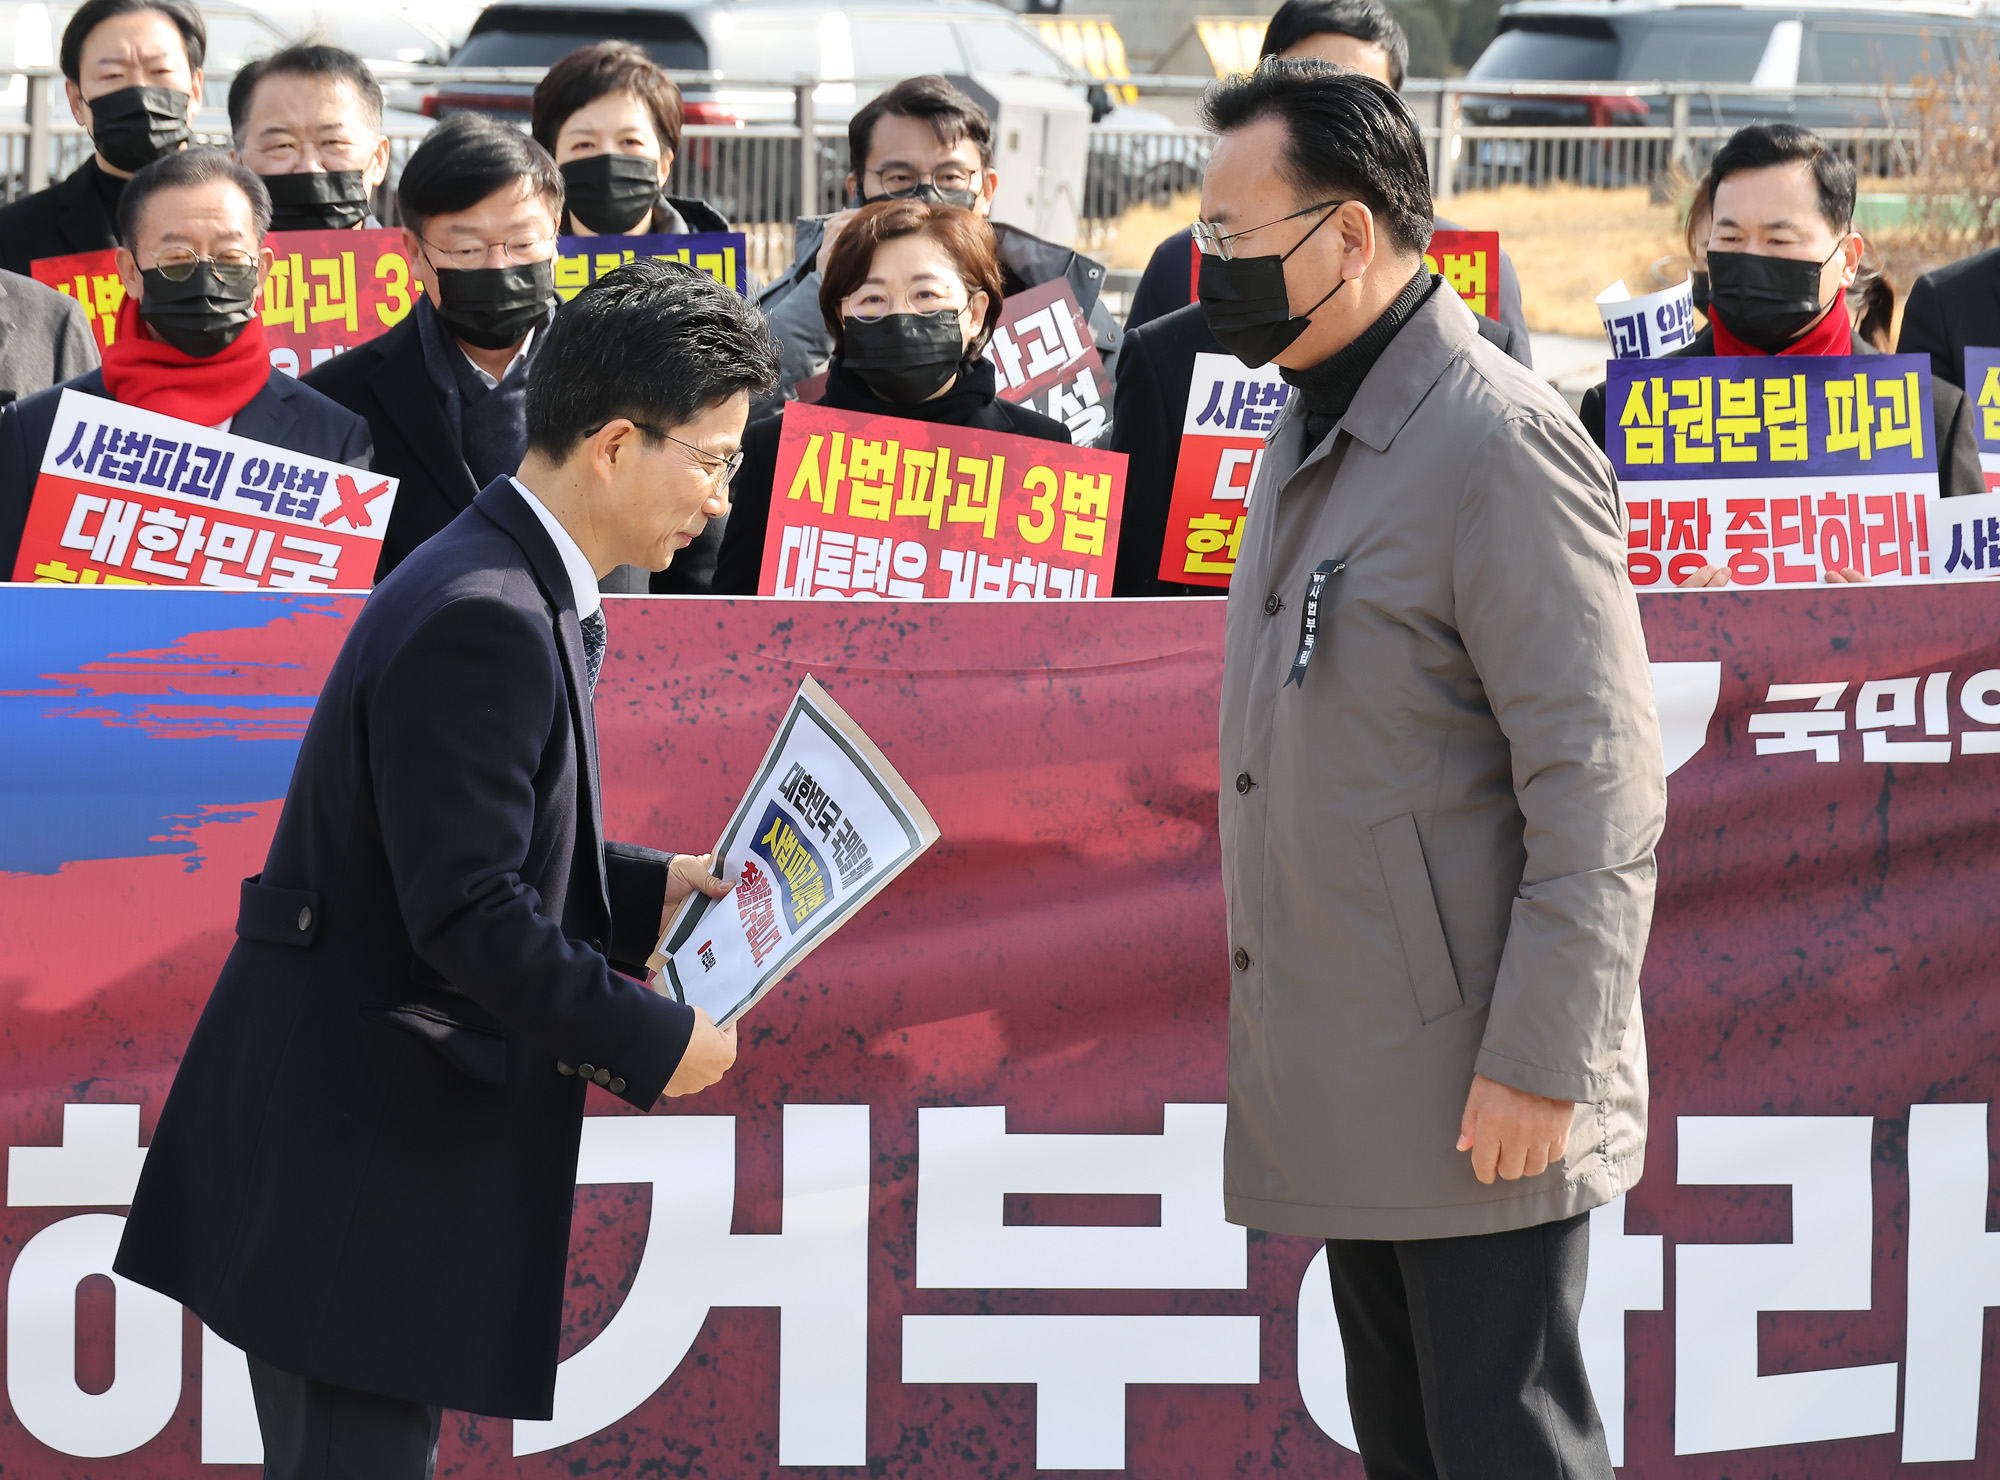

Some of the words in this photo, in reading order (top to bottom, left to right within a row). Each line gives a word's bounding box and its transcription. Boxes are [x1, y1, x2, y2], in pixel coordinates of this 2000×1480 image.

[261, 251, 359, 334] 파괴
[374, 252, 424, 328] 3
[1423, 251, 1486, 316] 법
[1196, 380, 1294, 431] 사법
[1619, 374, 1808, 465] 삼권분립
[1824, 371, 1924, 461] 파괴
[55, 421, 235, 501] 사법파괴
[236, 457, 329, 520] 악법
[786, 430, 1006, 540] 사법파괴
[1017, 465, 1112, 557] 3법
[60, 493, 342, 588] 대한민국
[1627, 498, 1711, 586] 당장
[1725, 491, 1931, 586] 중단하라!
[1944, 516, 2000, 574] 사
[761, 816, 819, 892] 사법파괴
[778, 761, 842, 843] 대한민국
[831, 817, 868, 876] 국민을
